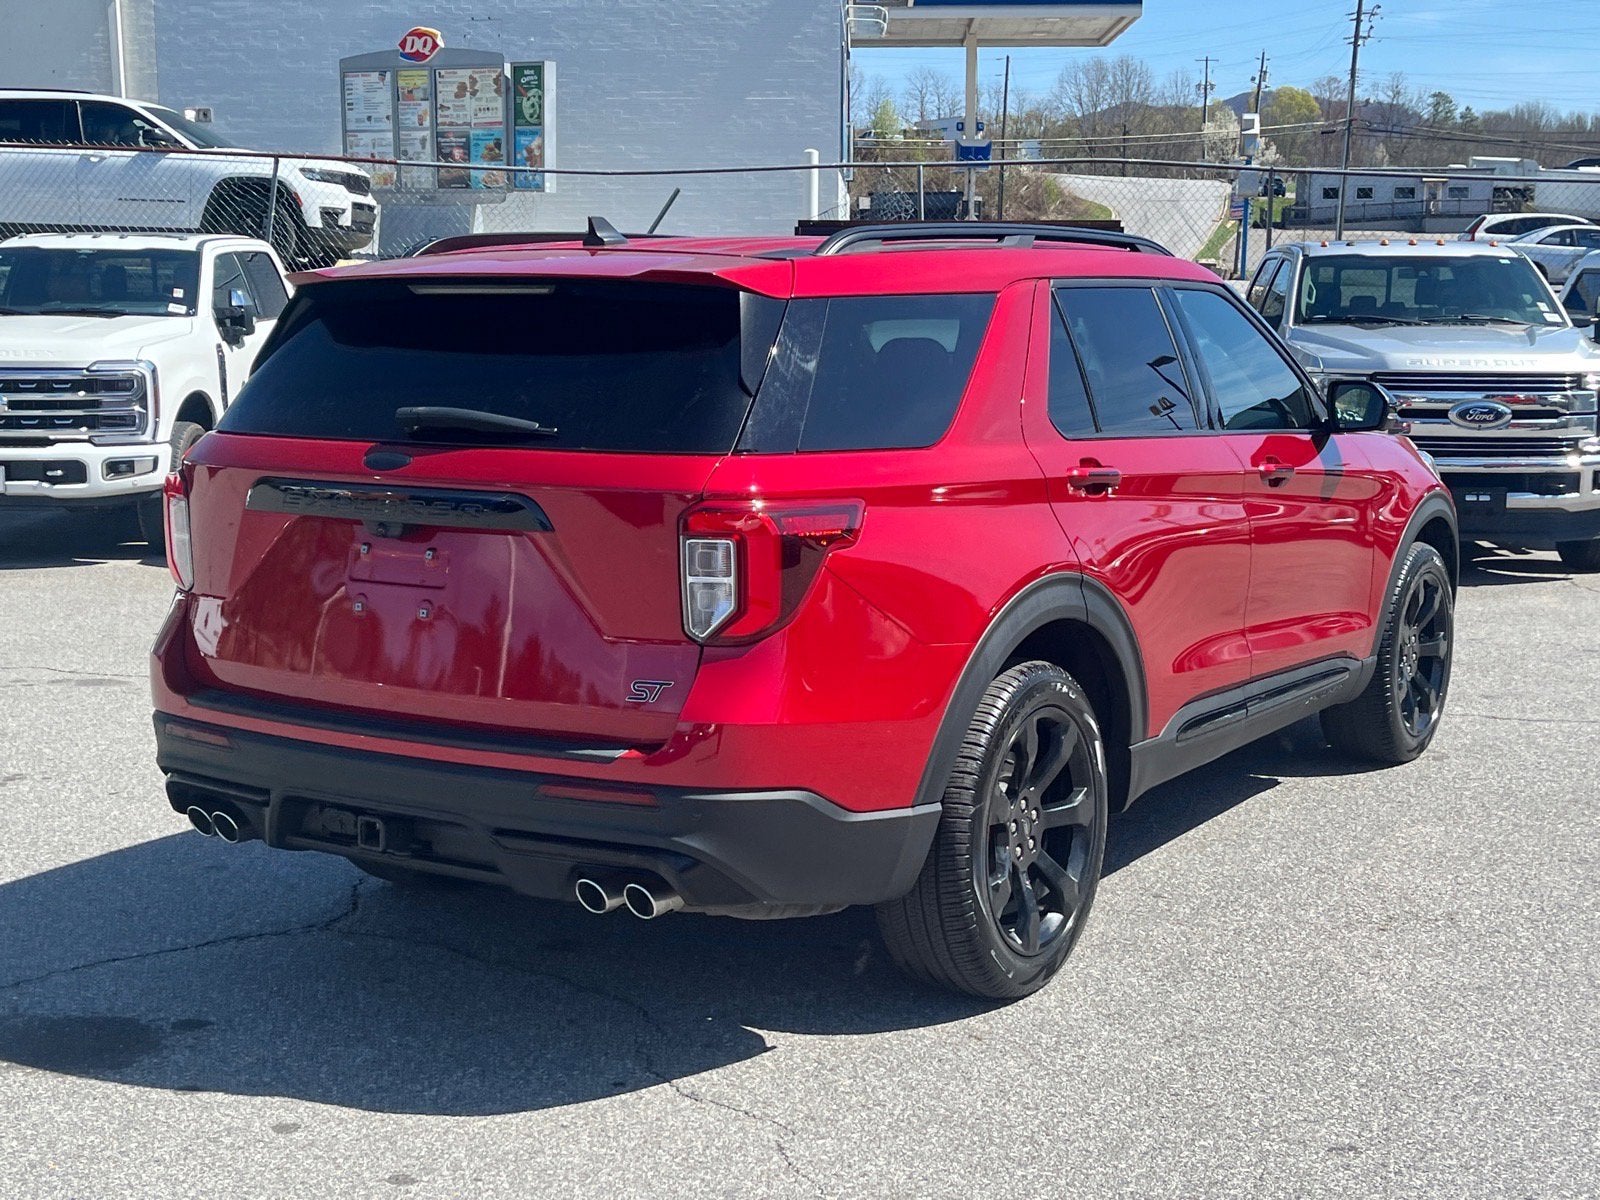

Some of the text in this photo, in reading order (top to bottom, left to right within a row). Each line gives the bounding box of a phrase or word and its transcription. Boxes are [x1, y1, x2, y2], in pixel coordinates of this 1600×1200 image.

[405, 36, 433, 55] DQ
[1466, 408, 1496, 421] Ford
[625, 679, 674, 703] ST
